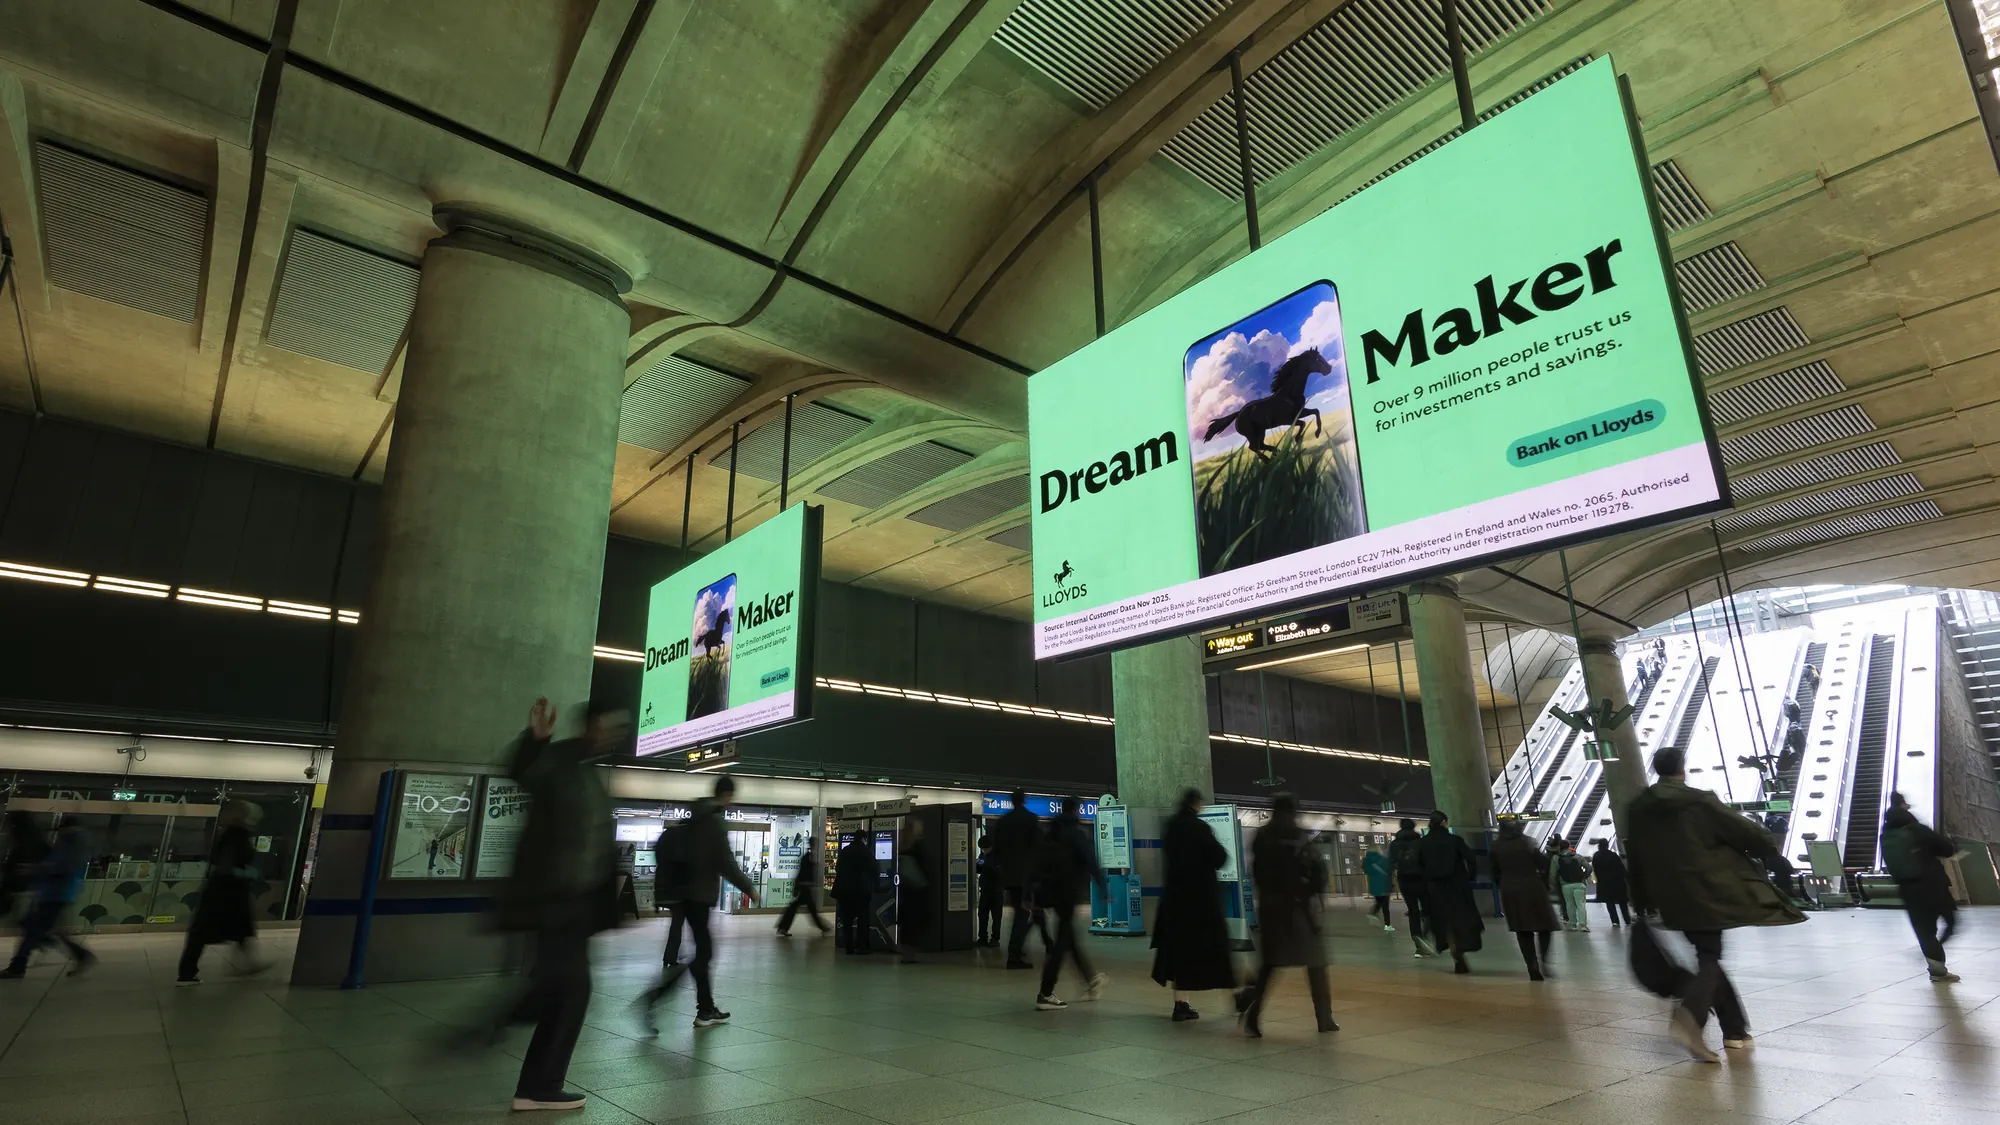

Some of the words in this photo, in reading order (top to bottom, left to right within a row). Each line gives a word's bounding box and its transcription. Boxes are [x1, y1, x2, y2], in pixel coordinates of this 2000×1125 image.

[1360, 238, 1623, 384] Maker
[1373, 392, 1410, 414] Over
[1413, 385, 1424, 400] 9
[1428, 366, 1482, 394] million
[1488, 341, 1550, 375] people
[1554, 319, 1603, 347] trust
[1608, 310, 1632, 327] us
[1375, 416, 1397, 433] for
[1400, 380, 1501, 424] investments
[1506, 363, 1541, 387] and
[1546, 336, 1623, 372] savings.
[1516, 438, 1562, 460] Bank
[1564, 431, 1588, 445] on
[1592, 409, 1654, 438] Lloyds
[1040, 431, 1179, 514] Dream
[1044, 633, 1058, 643] Lloyds
[1069, 627, 1084, 638] Lloyds
[1085, 624, 1097, 632] Bank
[1107, 618, 1125, 629] trading
[1126, 614, 1144, 624] names
[1144, 611, 1151, 619] of
[1151, 605, 1170, 618] Lloyds
[1170, 602, 1185, 611] Bank
[1186, 598, 1197, 609] plc.
[1198, 589, 1231, 603] Registered
[1233, 584, 1255, 595] Office:
[1256, 580, 1265, 590] 25
[1266, 573, 1298, 587] Gresham
[1299, 567, 1325, 579] Street,
[1325, 559, 1356, 572] London
[1357, 551, 1379, 564] EC2V
[1381, 546, 1403, 558] 7HN.
[1404, 532, 1452, 552] Registered
[1454, 531, 1464, 539] in
[1465, 520, 1505, 537] England
[1507, 515, 1527, 527] and
[1528, 507, 1562, 521] Wales
[1564, 503, 1582, 513] no.
[1585, 491, 1618, 508] 2065.
[1621, 473, 1690, 498] Authorised
[1050, 640, 1059, 649] the
[1059, 635, 1085, 647] Prudential
[1085, 628, 1111, 642] Regulation
[1112, 623, 1137, 637] Authority
[1137, 620, 1149, 629] and
[1149, 612, 1176, 628] regulated
[1177, 611, 1185, 620] by
[1185, 607, 1196, 617] the
[1196, 601, 1224, 613] Financial
[1225, 594, 1254, 607] Conduct
[1255, 585, 1289, 602] Authority
[1289, 582, 1304, 592] and
[1305, 577, 1319, 588] the
[1319, 568, 1360, 585] Prudential
[1361, 556, 1406, 576] Regulation
[1408, 546, 1451, 563] Authority
[1454, 539, 1482, 552] under
[1484, 523, 1544, 544] registration
[1546, 513, 1589, 530] number
[1591, 501, 1634, 519] 119278.
[1043, 584, 1088, 608] LLOYDS
[737, 590, 794, 634] Maker
[1044, 623, 1065, 633] Source:
[1065, 615, 1088, 628] Internal
[1089, 607, 1119, 624] Customer
[1119, 603, 1136, 613] Data
[1137, 600, 1150, 609] Nov
[1152, 594, 1171, 605] 2025.
[736, 642, 745, 651] Over
[750, 636, 762, 645] million
[762, 631, 775, 642] people
[775, 628, 784, 636] trust
[1215, 637, 1235, 648] Way
[1236, 632, 1254, 643] out
[1274, 624, 1288, 634] DLR
[1275, 629, 1306, 643] Elizabeth
[1306, 627, 1320, 636] line
[646, 637, 689, 672] Dream
[742, 645, 765, 658] investments
[761, 676, 771, 685] Bank
[776, 671, 789, 681] Lloyds
[640, 716, 655, 728] LLOYDS
[489, 785, 516, 795] SAVE
[489, 796, 502, 805] BY
[724, 810, 744, 820] Lab
[1079, 803, 1086, 814] &
